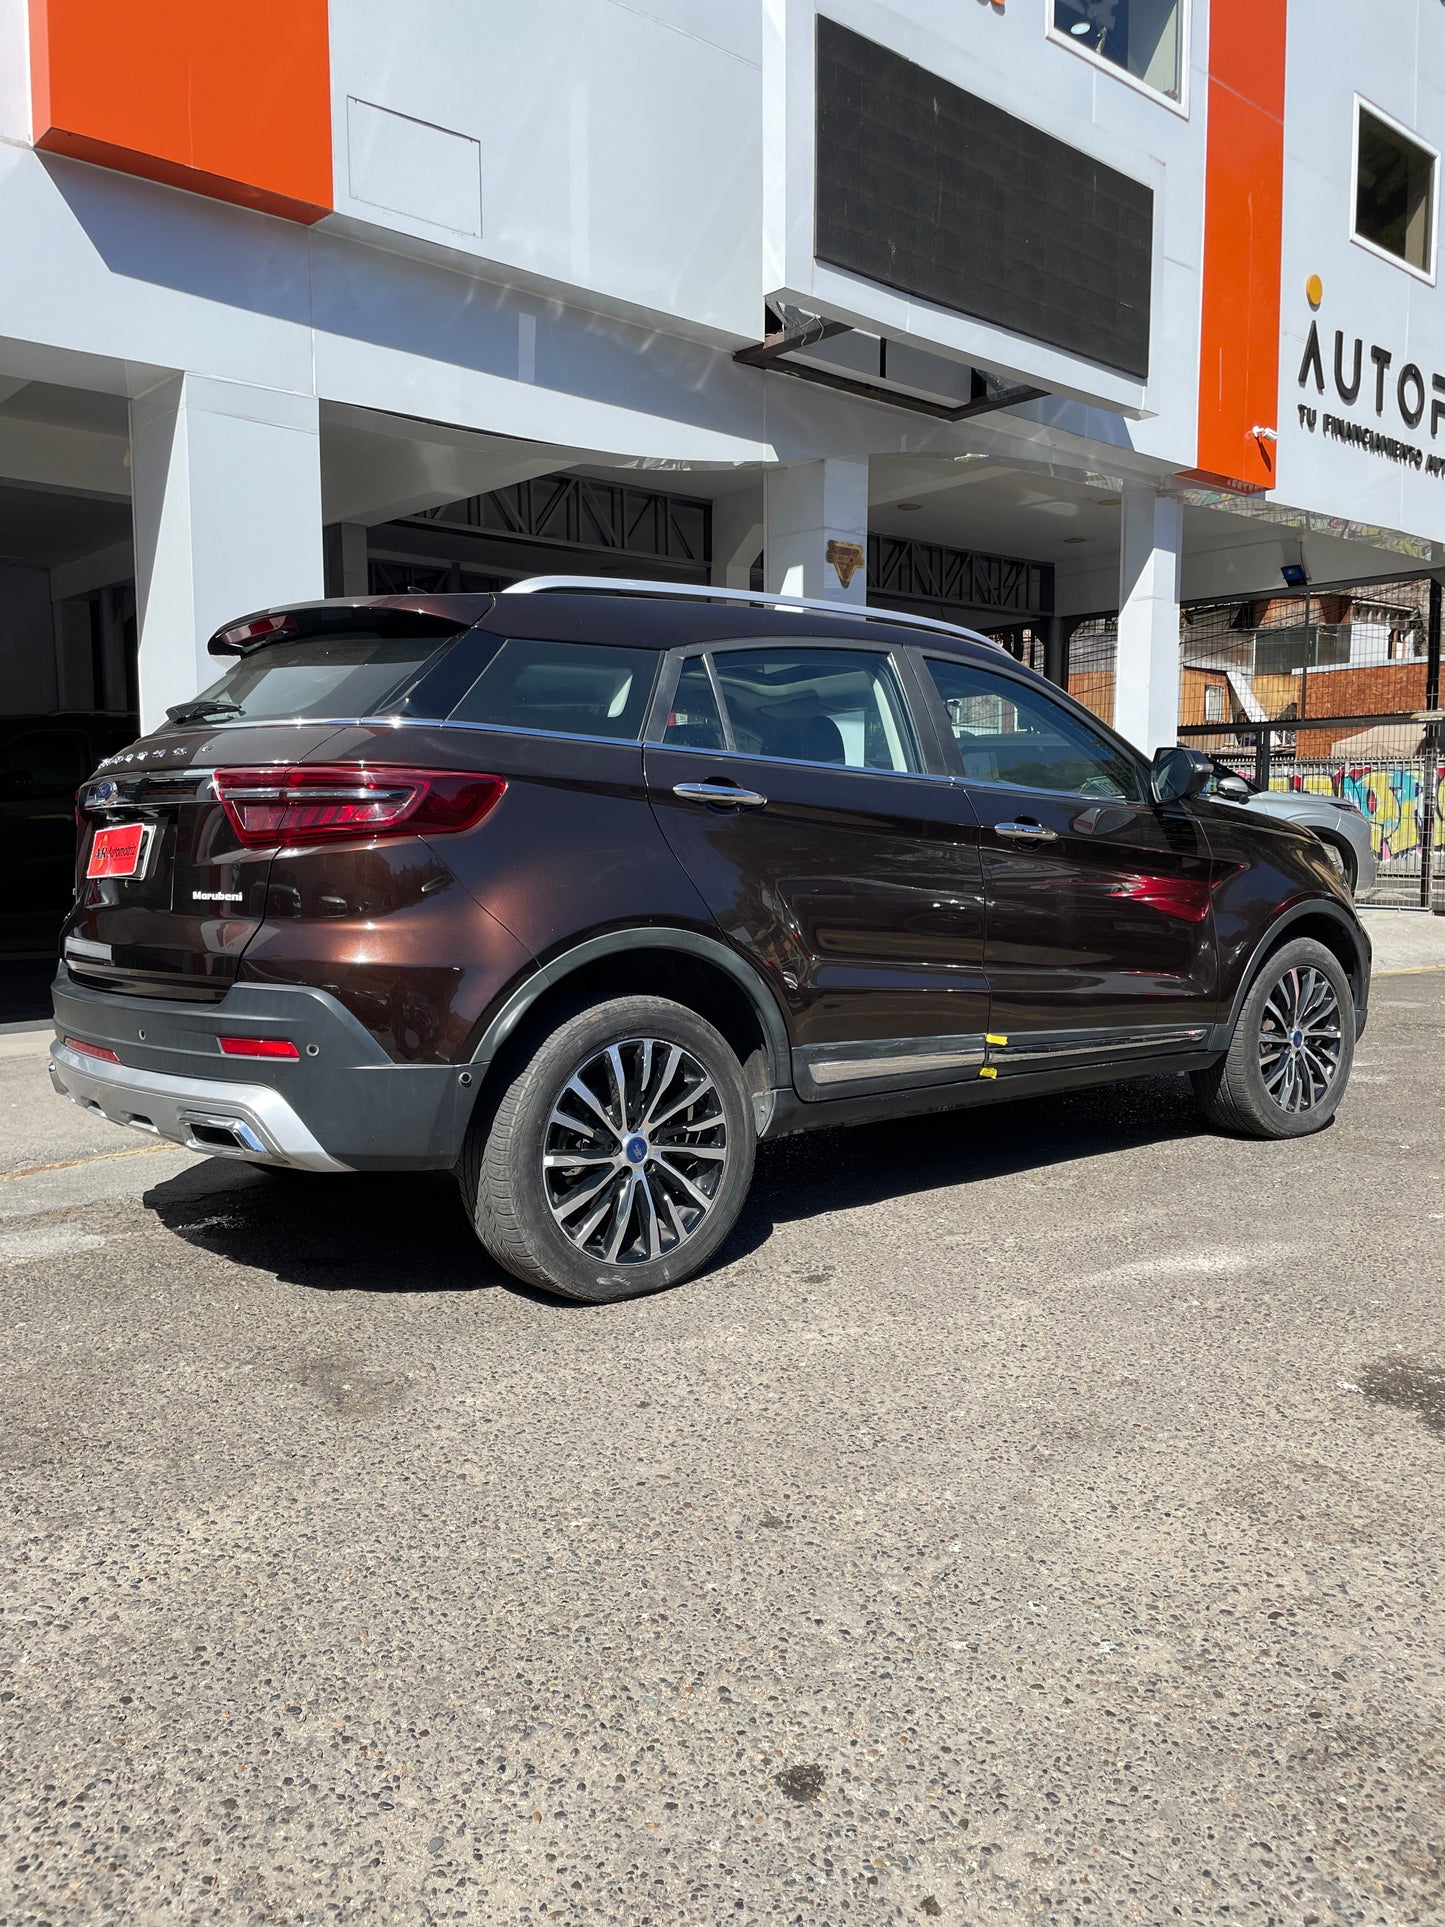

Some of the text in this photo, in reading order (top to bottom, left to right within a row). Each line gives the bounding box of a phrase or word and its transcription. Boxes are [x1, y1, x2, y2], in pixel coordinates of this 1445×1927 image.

[1297, 404, 1317, 429] TU
[1322, 413, 1423, 467] FINANCIAMIENTO
[192, 890, 243, 902] Marubeni
